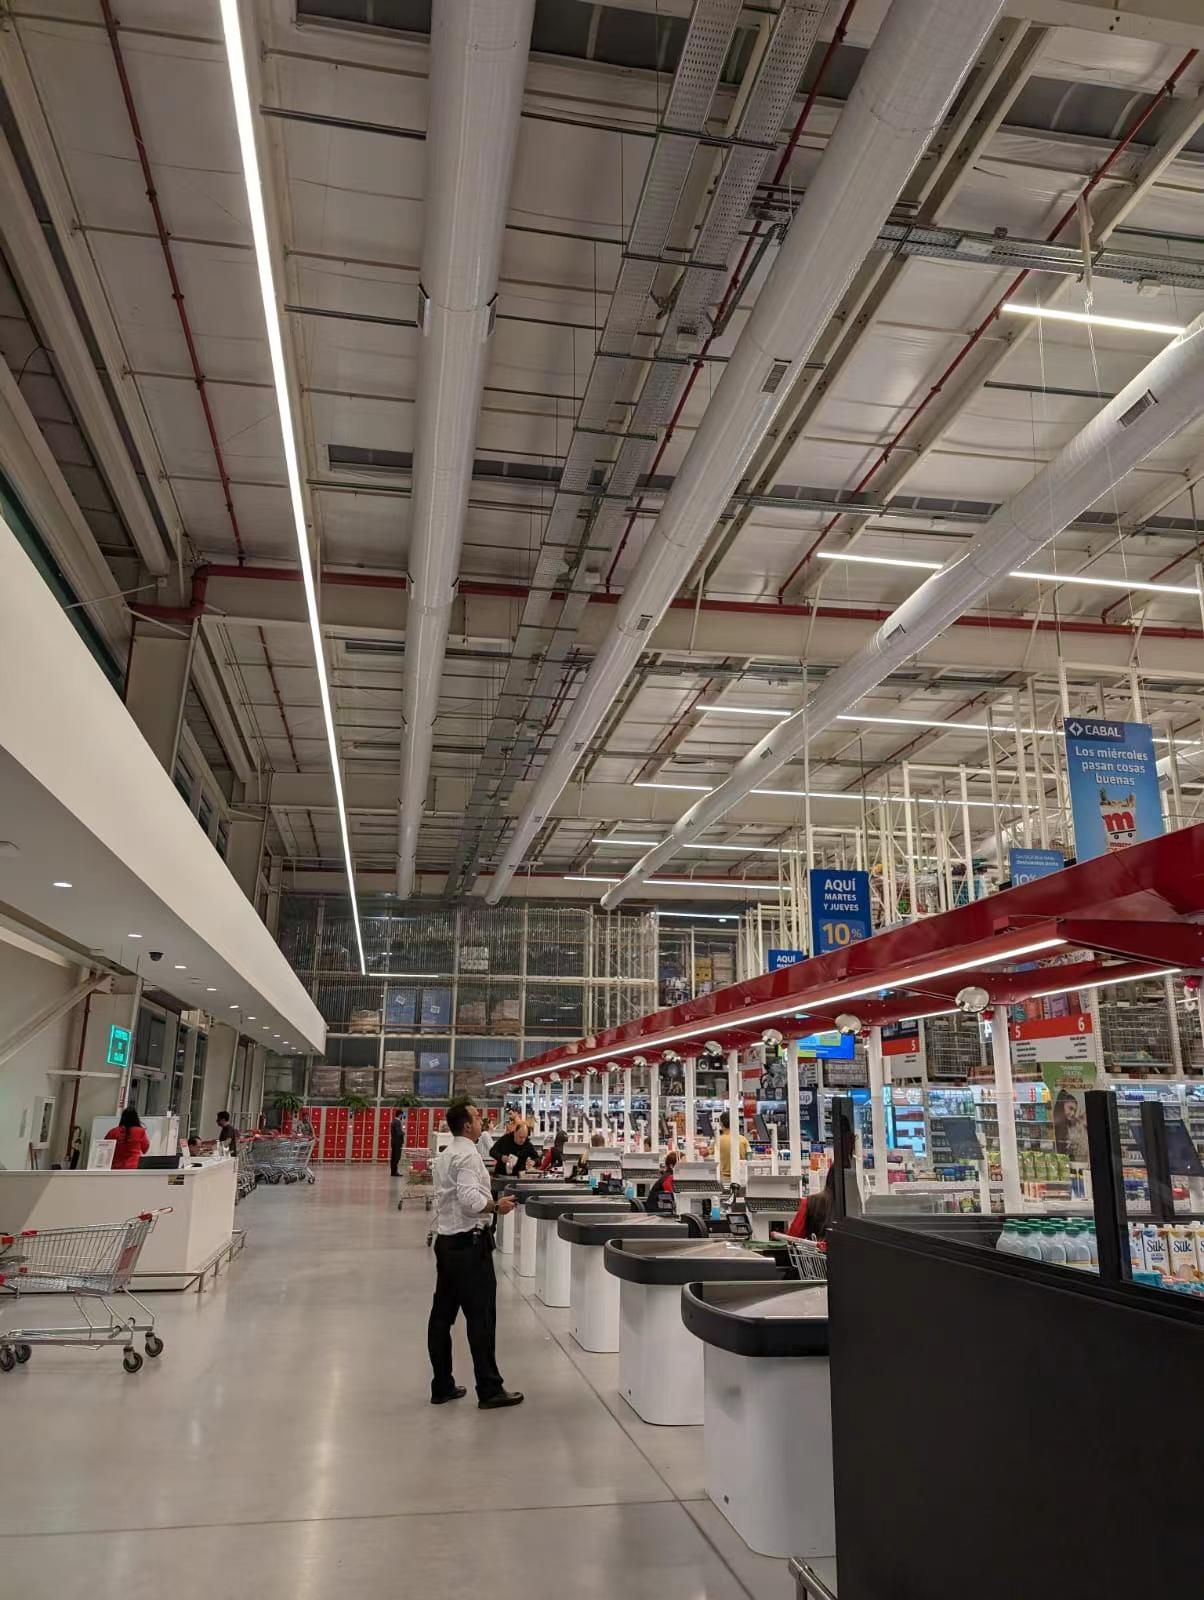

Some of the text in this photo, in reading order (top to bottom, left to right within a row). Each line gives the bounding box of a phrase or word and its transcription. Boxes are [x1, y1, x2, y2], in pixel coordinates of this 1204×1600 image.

[1085, 725, 1122, 737] CABAL
[1075, 746, 1148, 760] Los miércoles
[1082, 761, 1145, 773] pasan cosas
[1096, 773, 1135, 785] buenas
[824, 878, 856, 892] AQUÍ
[824, 893, 857, 901] MARTES
[1015, 1017, 1085, 1039] 5 6
[911, 1039, 916, 1051] 5
[1147, 1239, 1165, 1253] Silk
[1173, 1239, 1192, 1253] Silk
